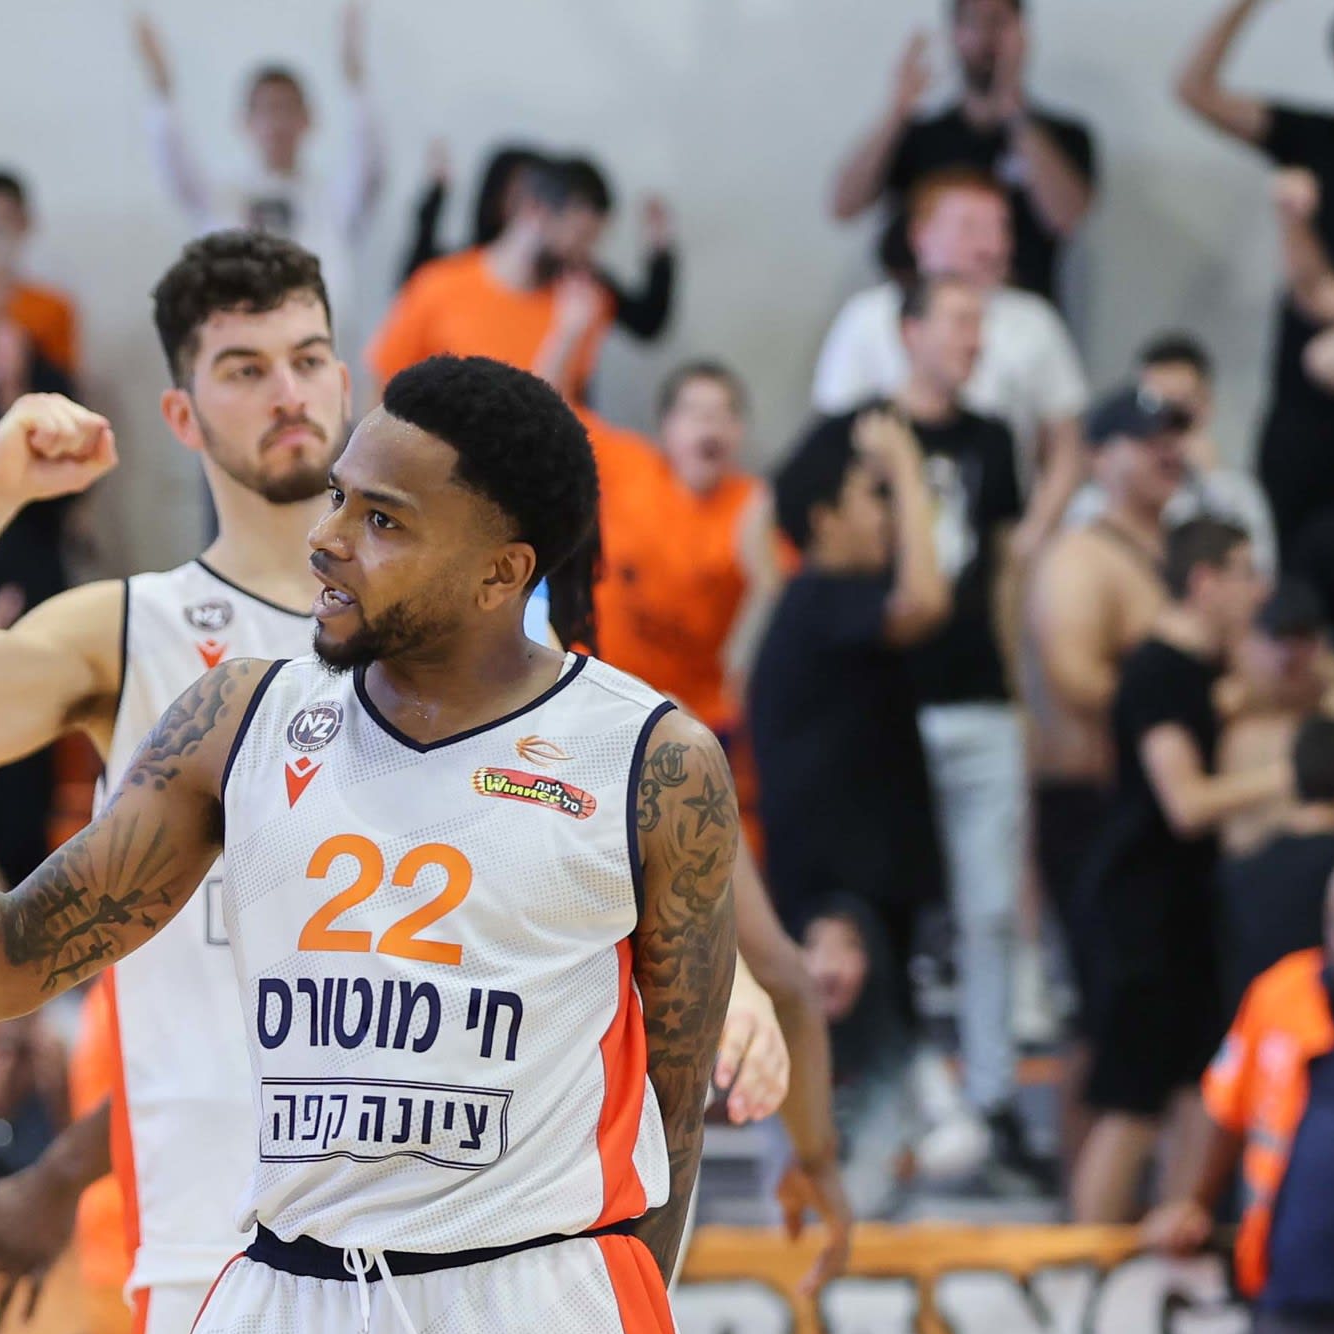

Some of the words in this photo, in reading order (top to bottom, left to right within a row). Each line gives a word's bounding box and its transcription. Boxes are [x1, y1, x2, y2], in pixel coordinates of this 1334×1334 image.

[298, 713, 334, 738] NZ
[485, 775, 561, 804] Winner
[562, 796, 579, 812] סל
[298, 834, 472, 965] 22
[257, 977, 441, 1053] מוטורס
[465, 988, 524, 1061] חי
[273, 1094, 348, 1149] קפה
[358, 1095, 489, 1149] ציונה
